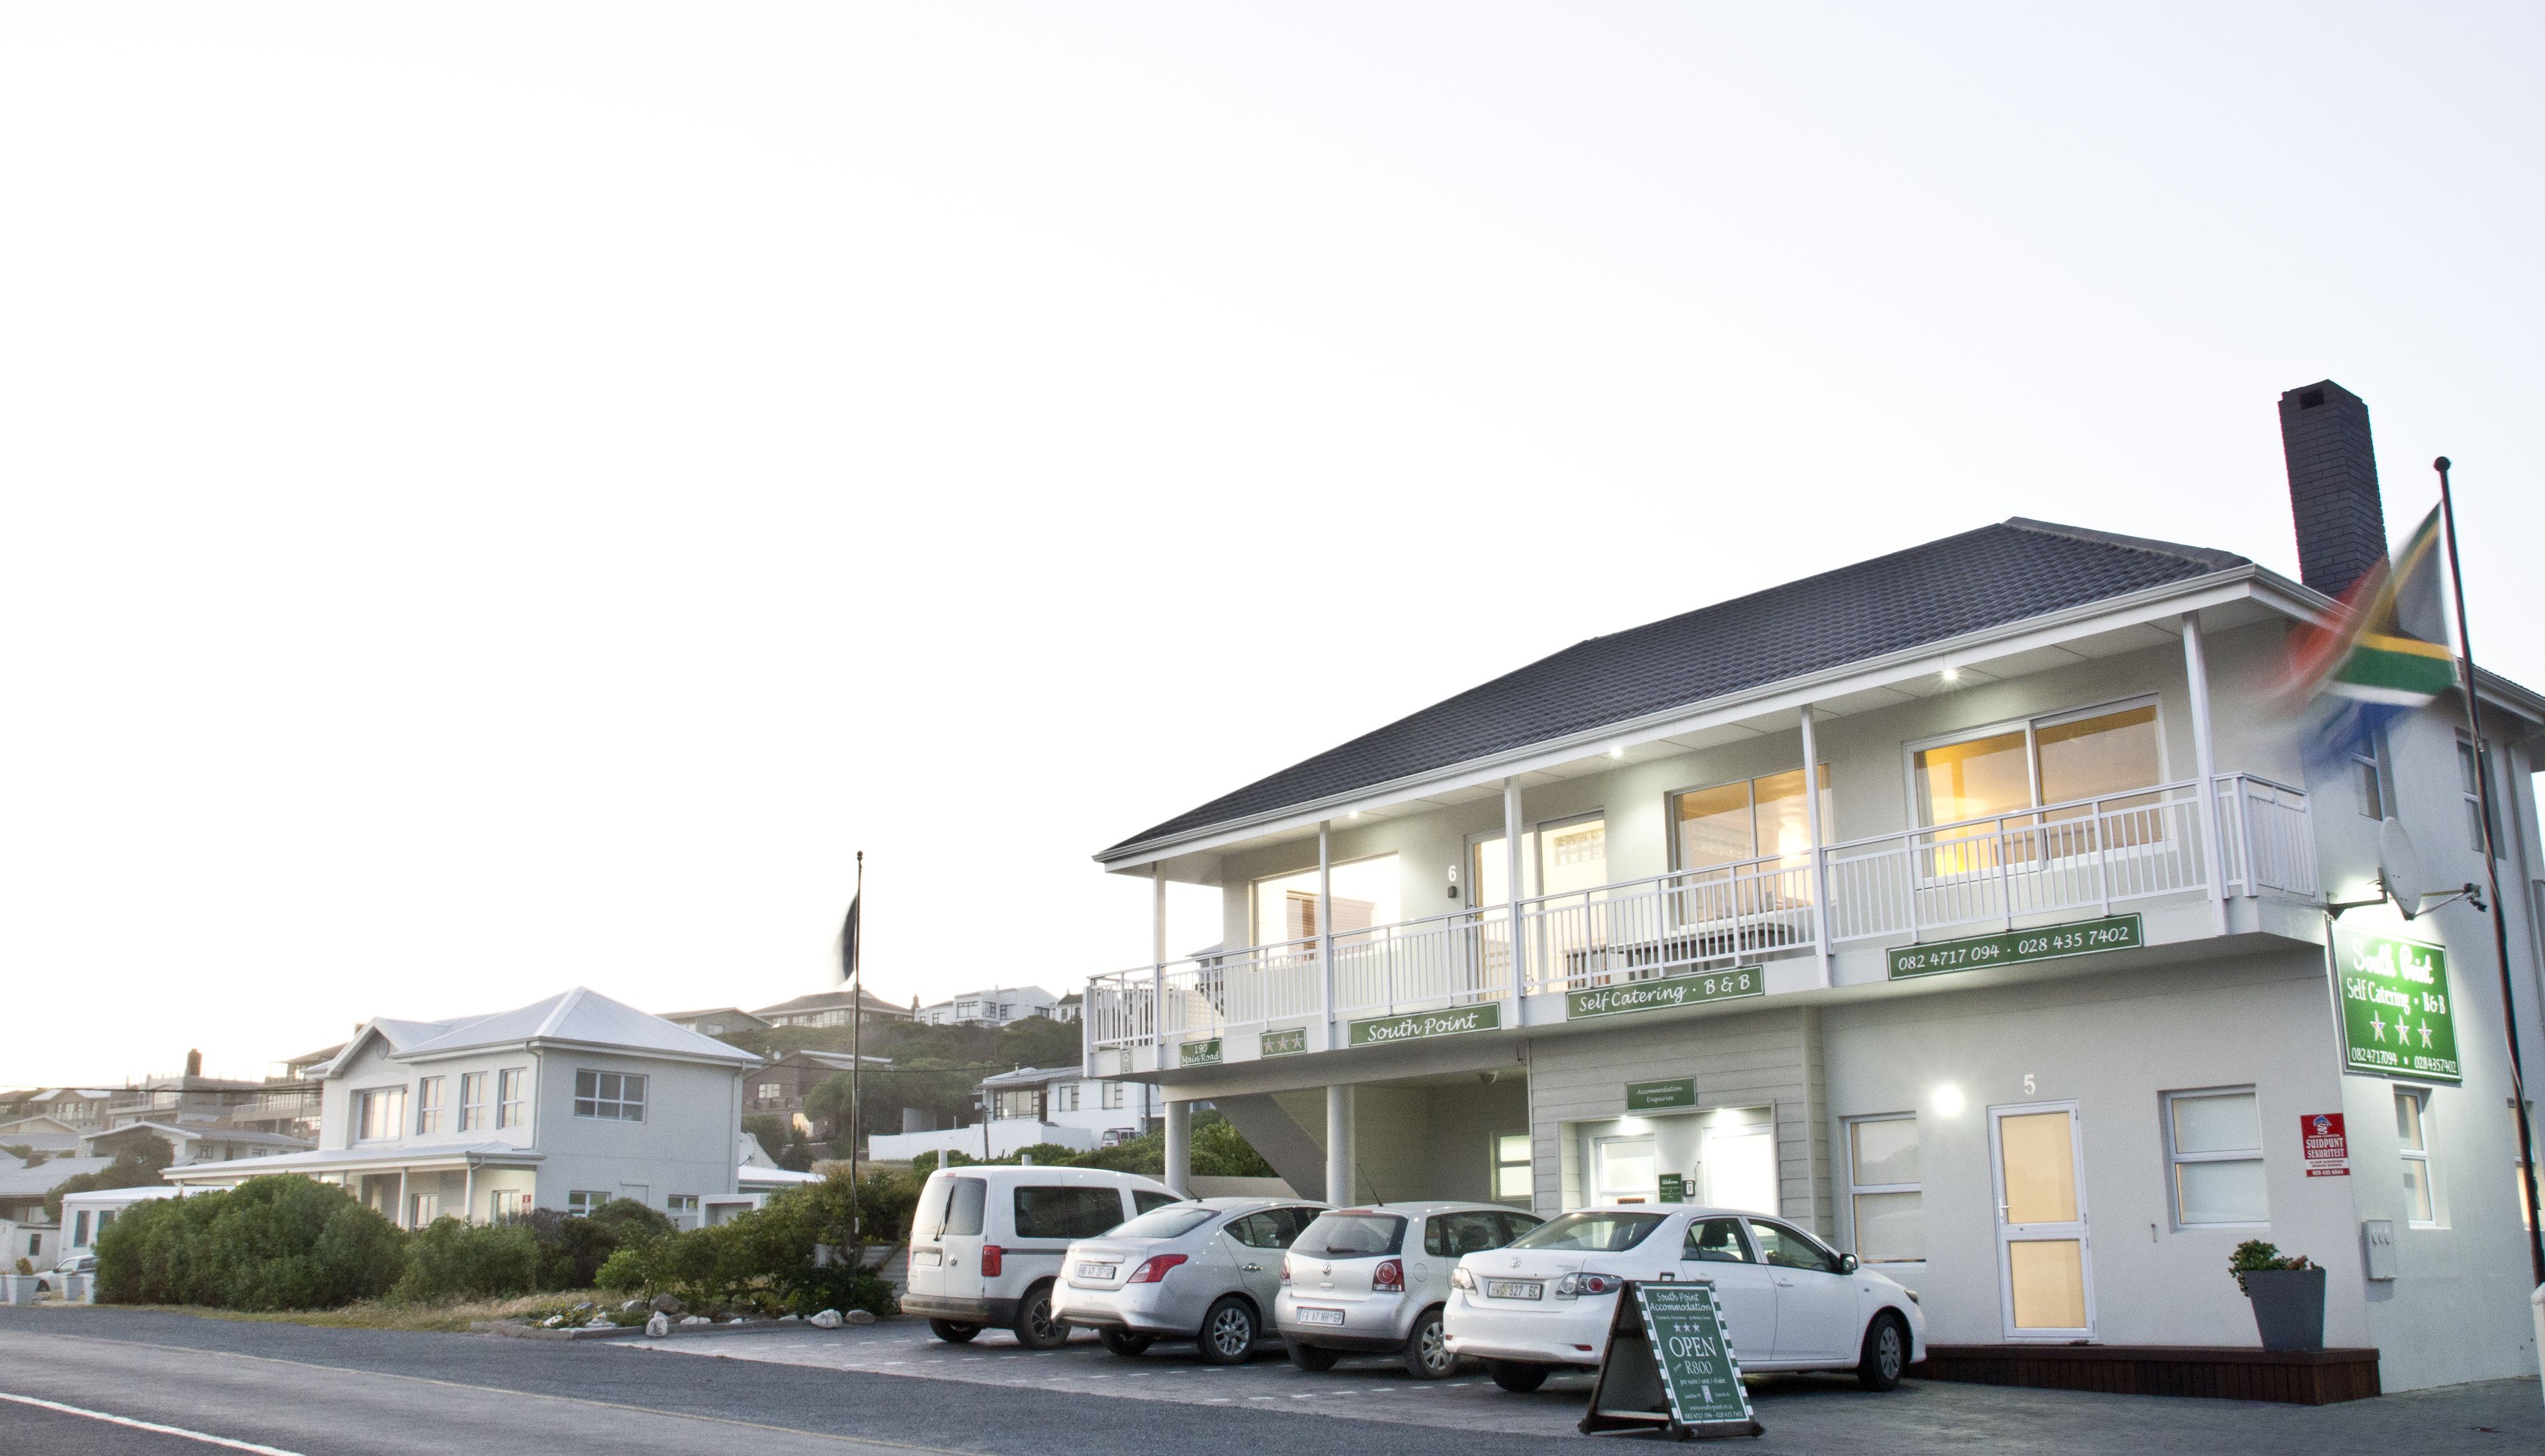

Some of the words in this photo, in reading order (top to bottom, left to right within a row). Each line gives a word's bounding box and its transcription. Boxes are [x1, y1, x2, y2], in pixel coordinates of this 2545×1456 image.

[1449, 865, 1456, 881] 6
[1898, 955, 1925, 970] 082
[1930, 949, 1966, 965] 4717
[1971, 944, 2000, 960] 094
[2019, 938, 2047, 954] 028
[2053, 932, 2082, 949] 435
[2089, 926, 2129, 945] 7402
[1579, 991, 1609, 1012] Self
[1611, 985, 1687, 1003] Catering
[1705, 979, 1715, 994] B
[1738, 974, 1750, 989] B
[2347, 978, 2367, 1001] Self
[2368, 981, 2410, 1015] Catering
[1367, 1019, 1422, 1041] South
[1424, 1013, 1479, 1035] Point
[1194, 1044, 1208, 1054] 190
[1182, 1054, 1200, 1064] Main
[1201, 1050, 1220, 1062] Road
[1636, 1086, 1682, 1095] Accommodation
[2024, 1074, 2035, 1095] 5
[2306, 1137, 2344, 1148] SUIDPUNT
[2307, 1148, 2344, 1158] SEKURITEIT
[1509, 1285, 1523, 1296] 827
[1528, 1286, 1538, 1297] EC
[1657, 1292, 1679, 1302] South
[1679, 1292, 1699, 1302] Point
[1650, 1302, 1713, 1312] Accommodation
[1669, 1336, 1717, 1357] OPEN
[1685, 1360, 1713, 1374] R800
